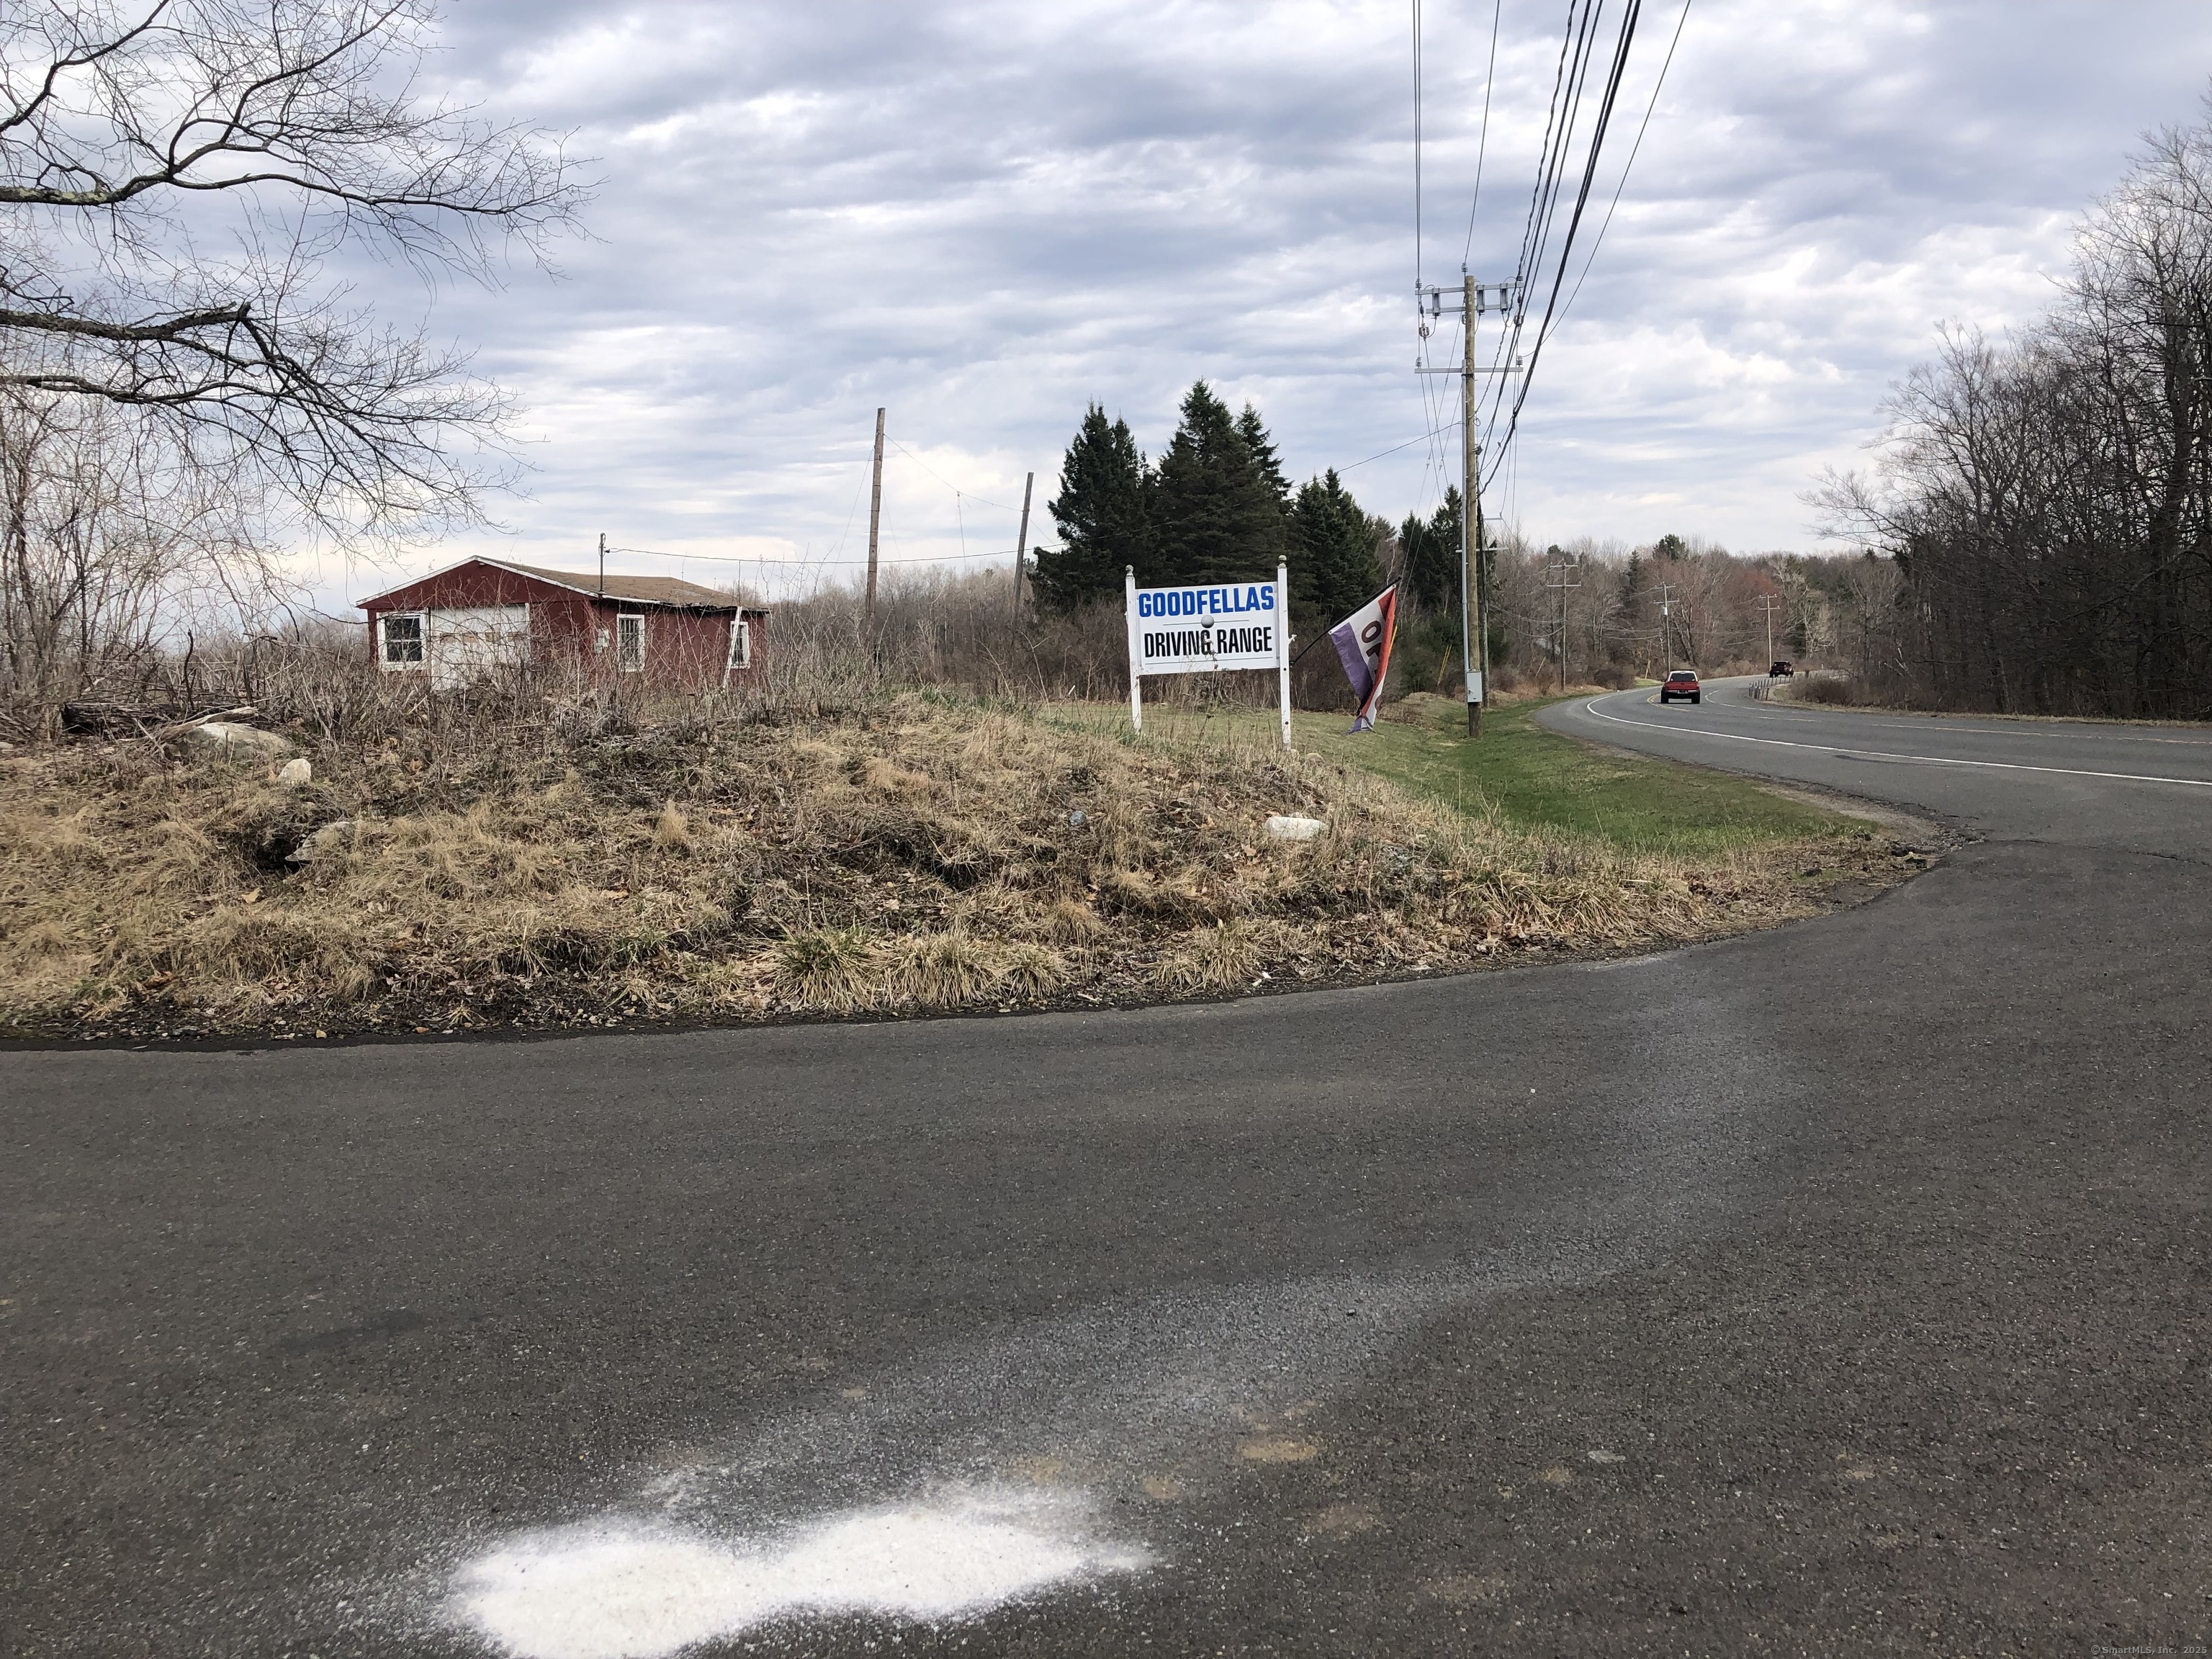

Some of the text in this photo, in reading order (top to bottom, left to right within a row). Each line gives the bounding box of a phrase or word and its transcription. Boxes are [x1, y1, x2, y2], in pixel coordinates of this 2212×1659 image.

[1138, 585, 1274, 617] GOODFELLAS
[1144, 626, 1272, 658] DRIVING RANGE
